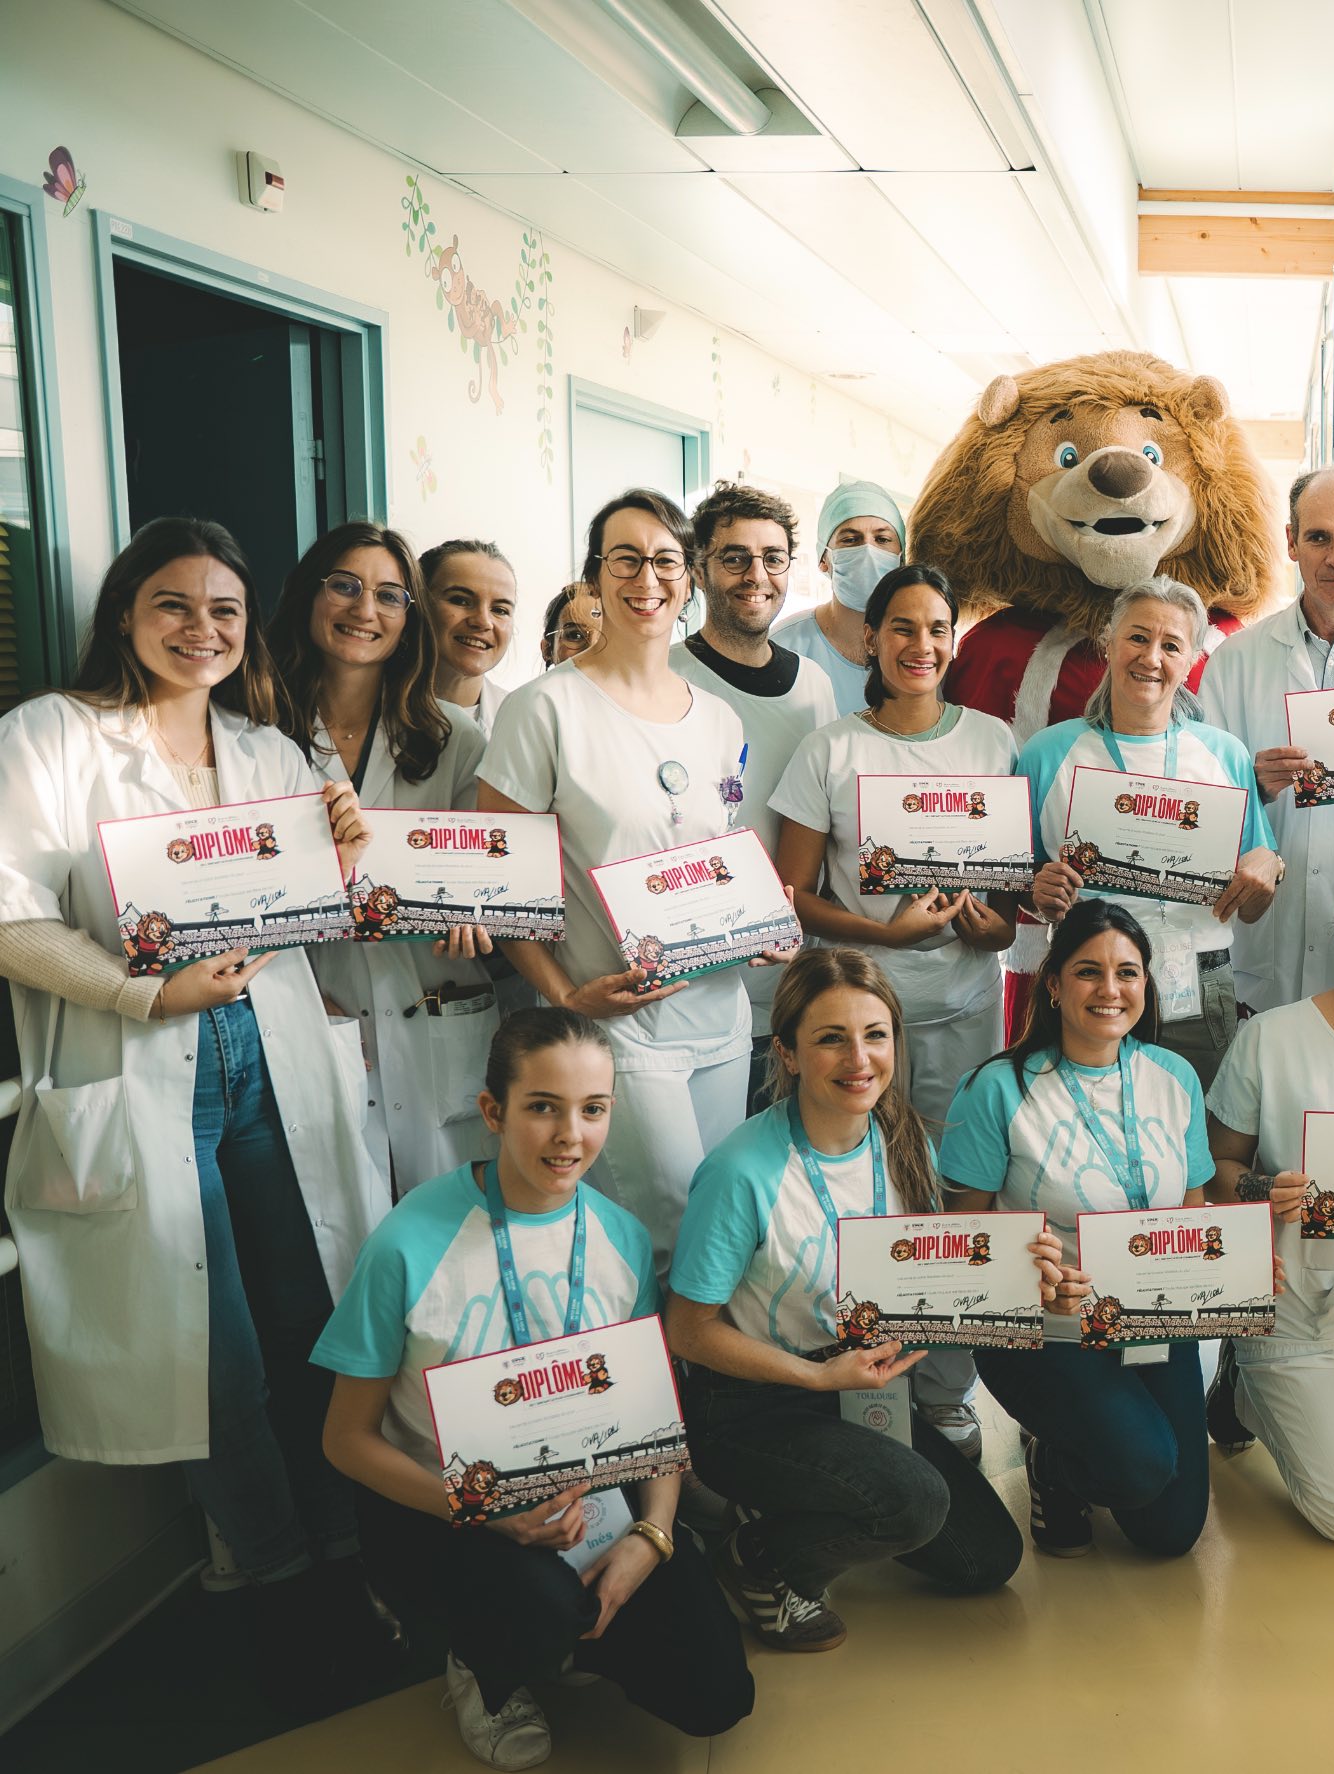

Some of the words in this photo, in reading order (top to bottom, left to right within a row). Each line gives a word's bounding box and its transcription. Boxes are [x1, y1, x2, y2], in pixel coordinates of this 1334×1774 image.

[920, 789, 970, 813] DIPLÔME
[1131, 794, 1183, 820] DIPLÔME
[189, 826, 258, 861] DIPLÔME
[429, 824, 489, 850] DIPLÔME
[661, 860, 715, 891] DIPLÔME
[1149, 943, 1193, 954] OULOUSE
[911, 1231, 972, 1260] DIPLÔME
[1148, 1226, 1206, 1255] DIPLÔME
[517, 1359, 589, 1401] DIPLÔME
[856, 1392, 898, 1400] TOULOUSE
